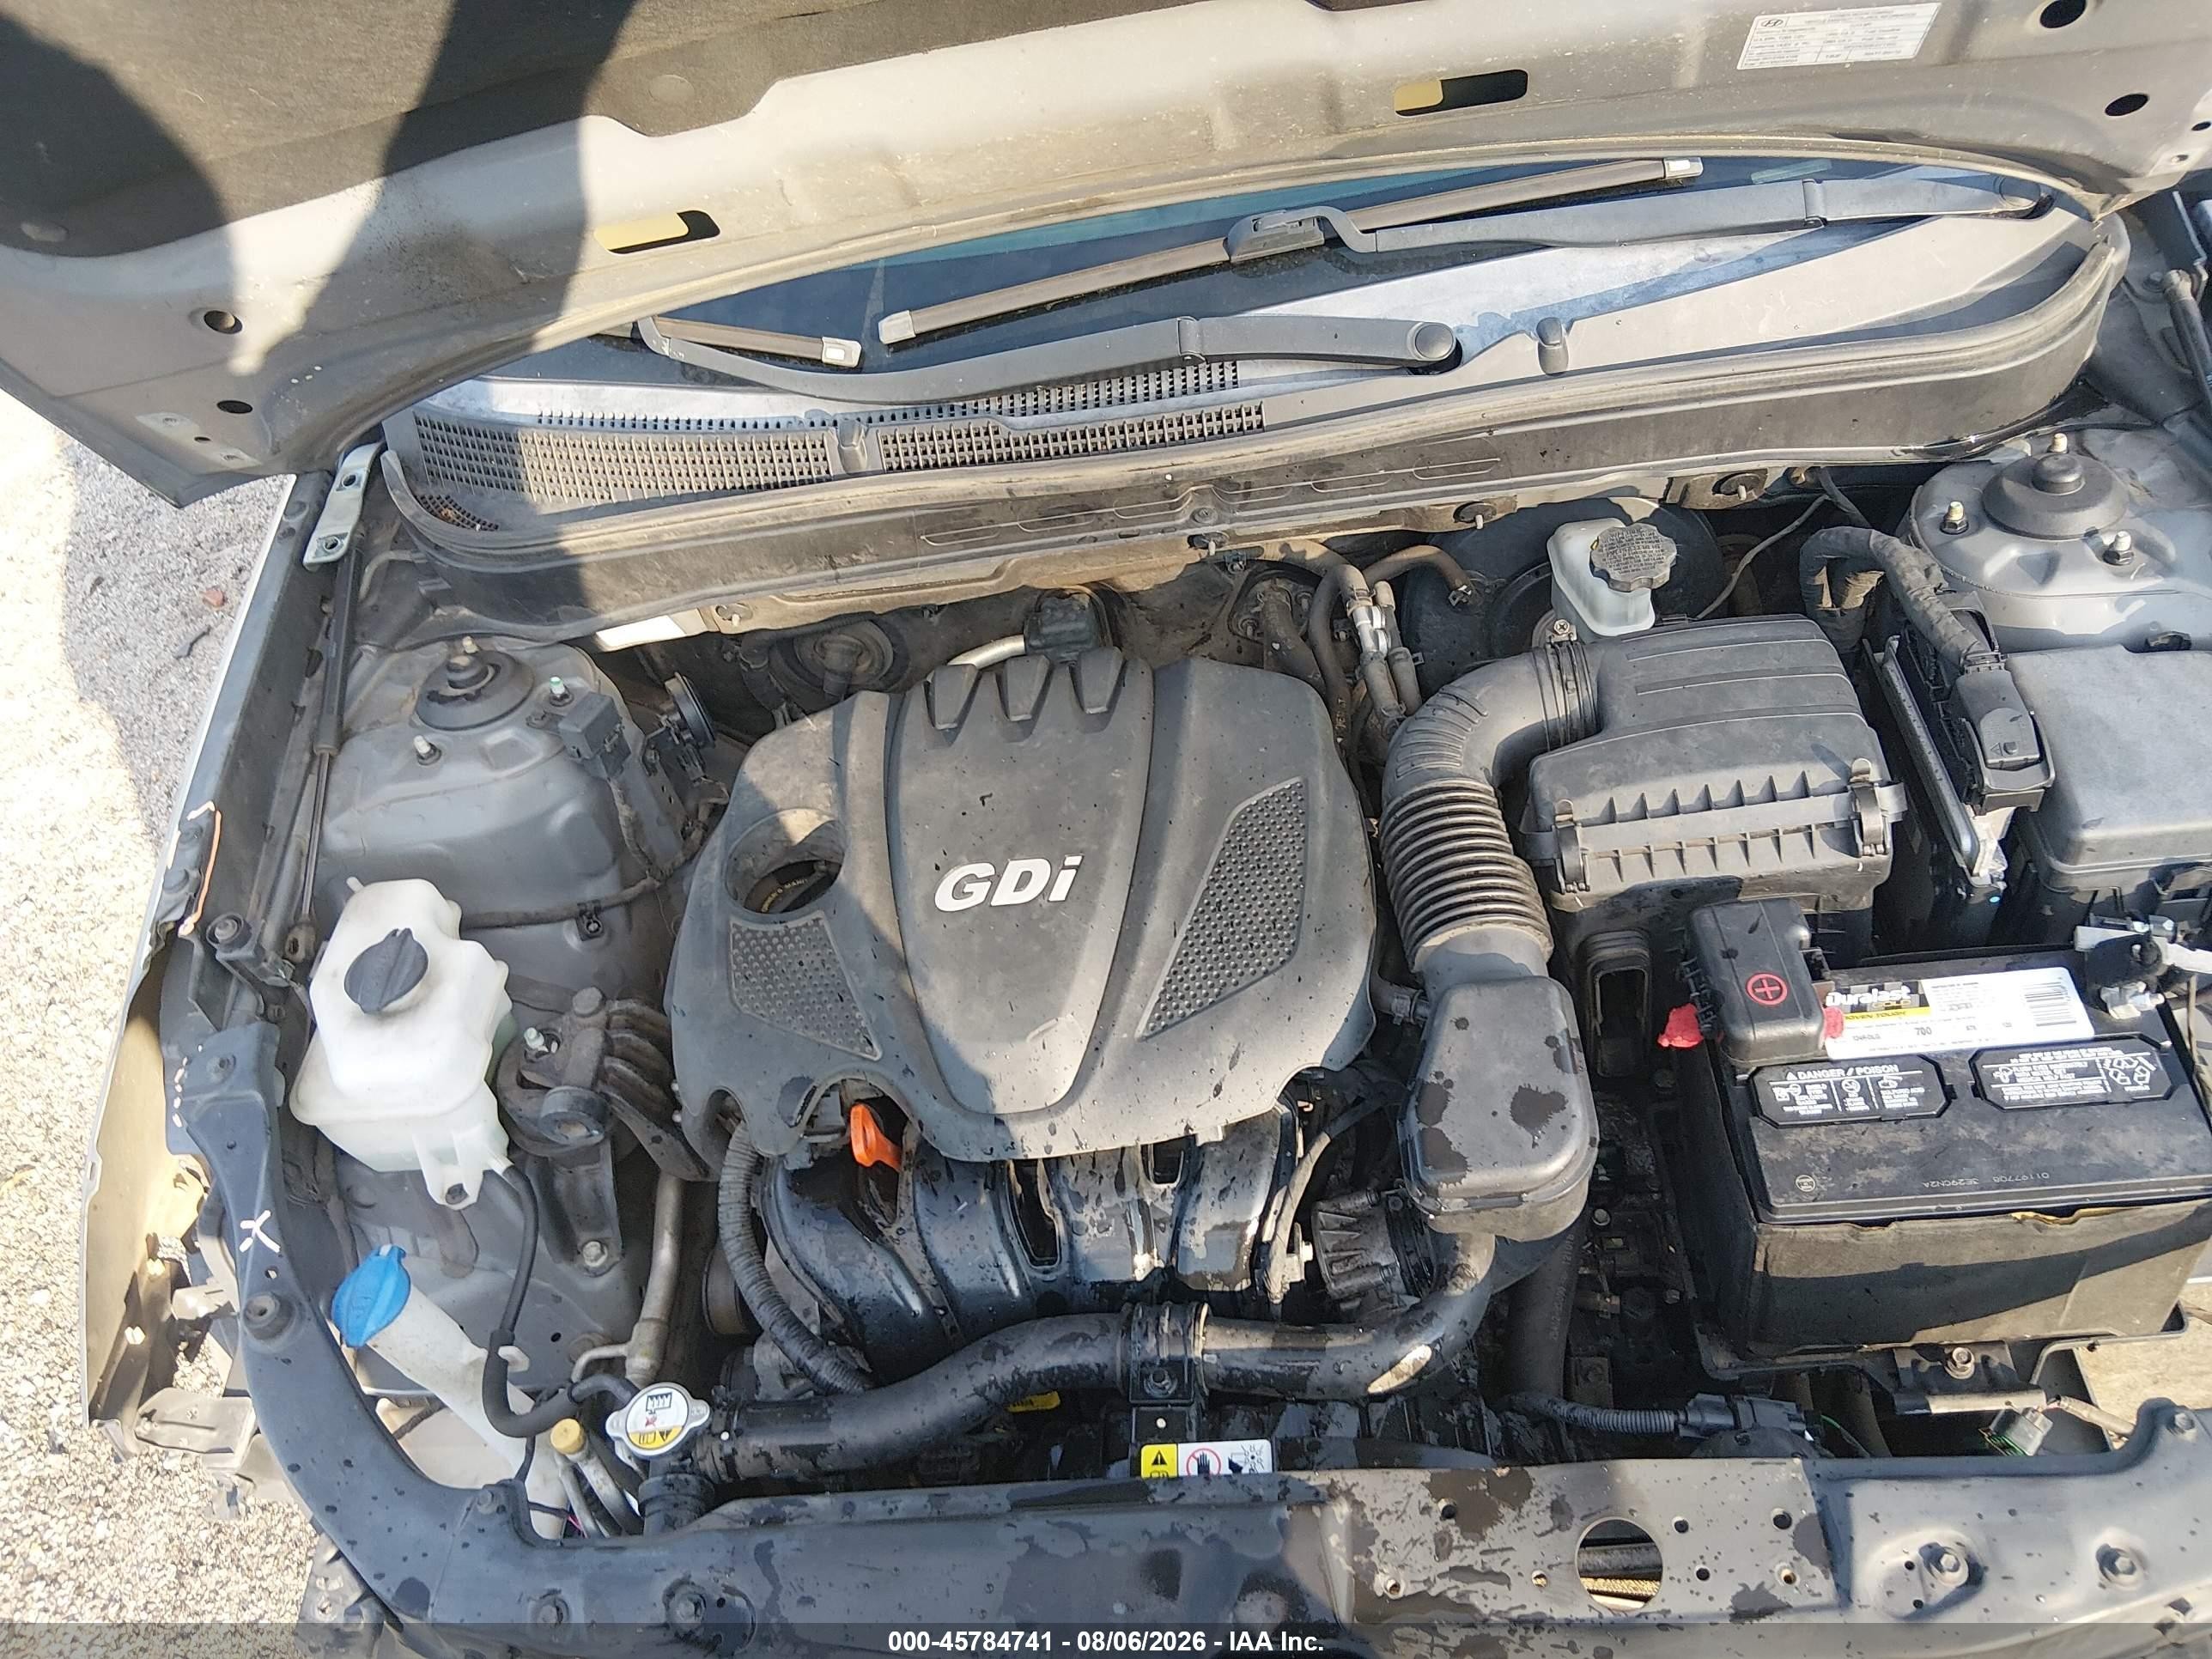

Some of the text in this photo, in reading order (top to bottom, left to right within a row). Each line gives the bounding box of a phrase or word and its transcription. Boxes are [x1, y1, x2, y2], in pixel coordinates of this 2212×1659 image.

[934, 854, 1085, 913] GDi
[1826, 985, 1911, 1006] Duralast
[1914, 1026, 1932, 1036] 700
[1797, 1069, 1845, 1079] DANGER
[1856, 1064, 1899, 1075] POISON
